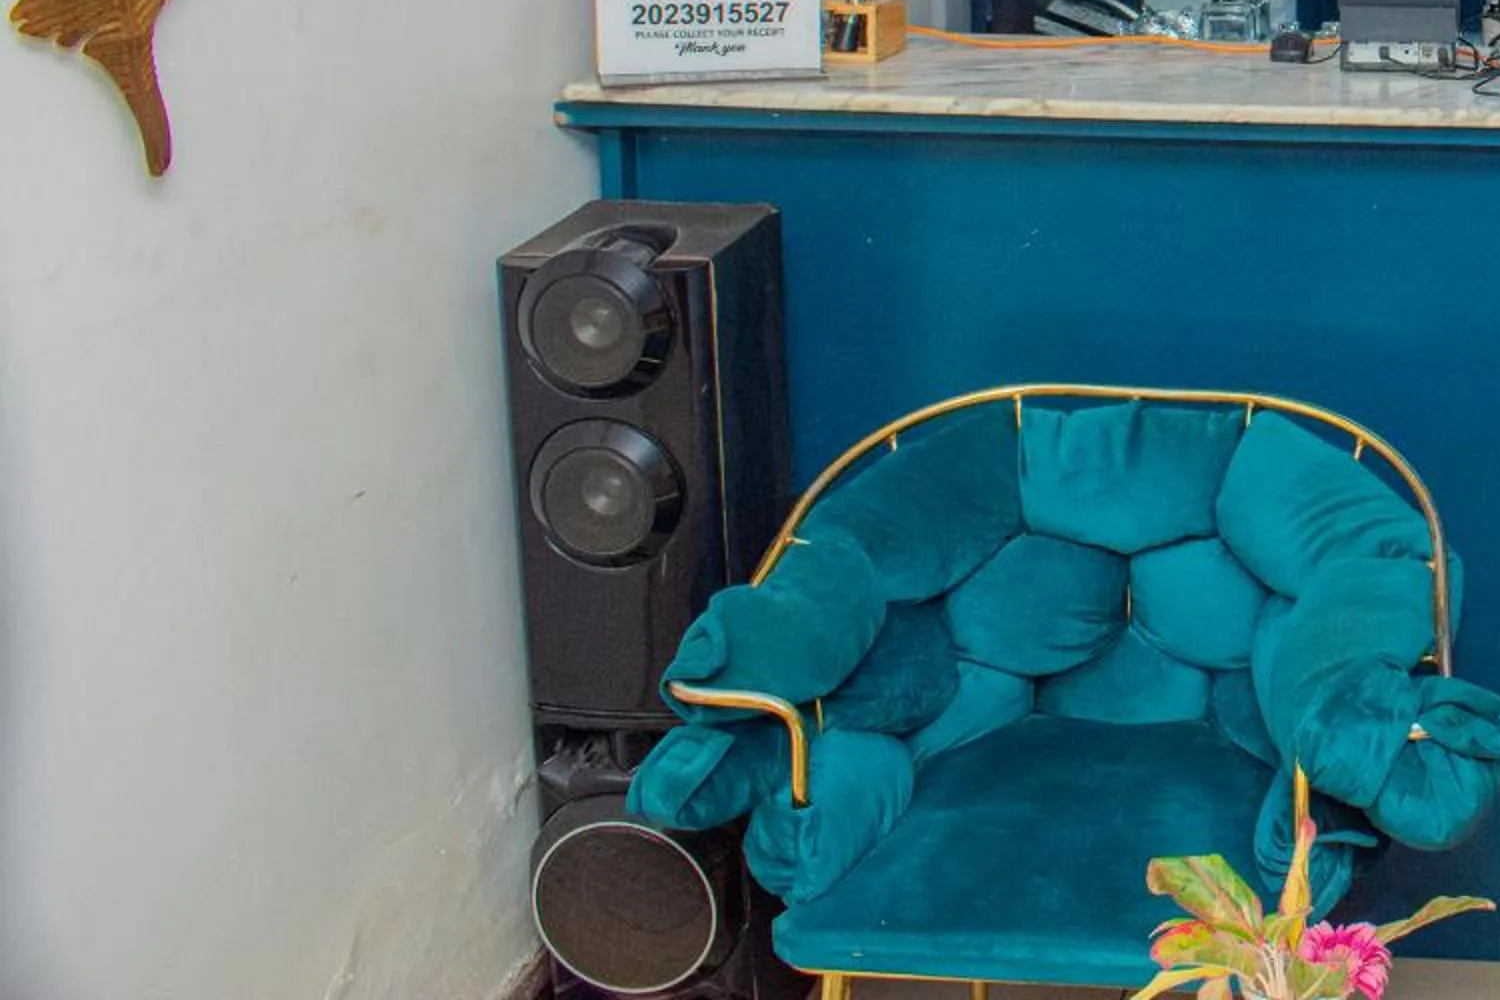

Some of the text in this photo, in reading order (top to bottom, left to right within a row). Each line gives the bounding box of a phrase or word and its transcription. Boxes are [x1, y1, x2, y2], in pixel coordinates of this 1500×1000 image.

[631, 1, 790, 26] 2023915527
[635, 26, 786, 40] PLEASE COLLECT YOUR RECEIPT
